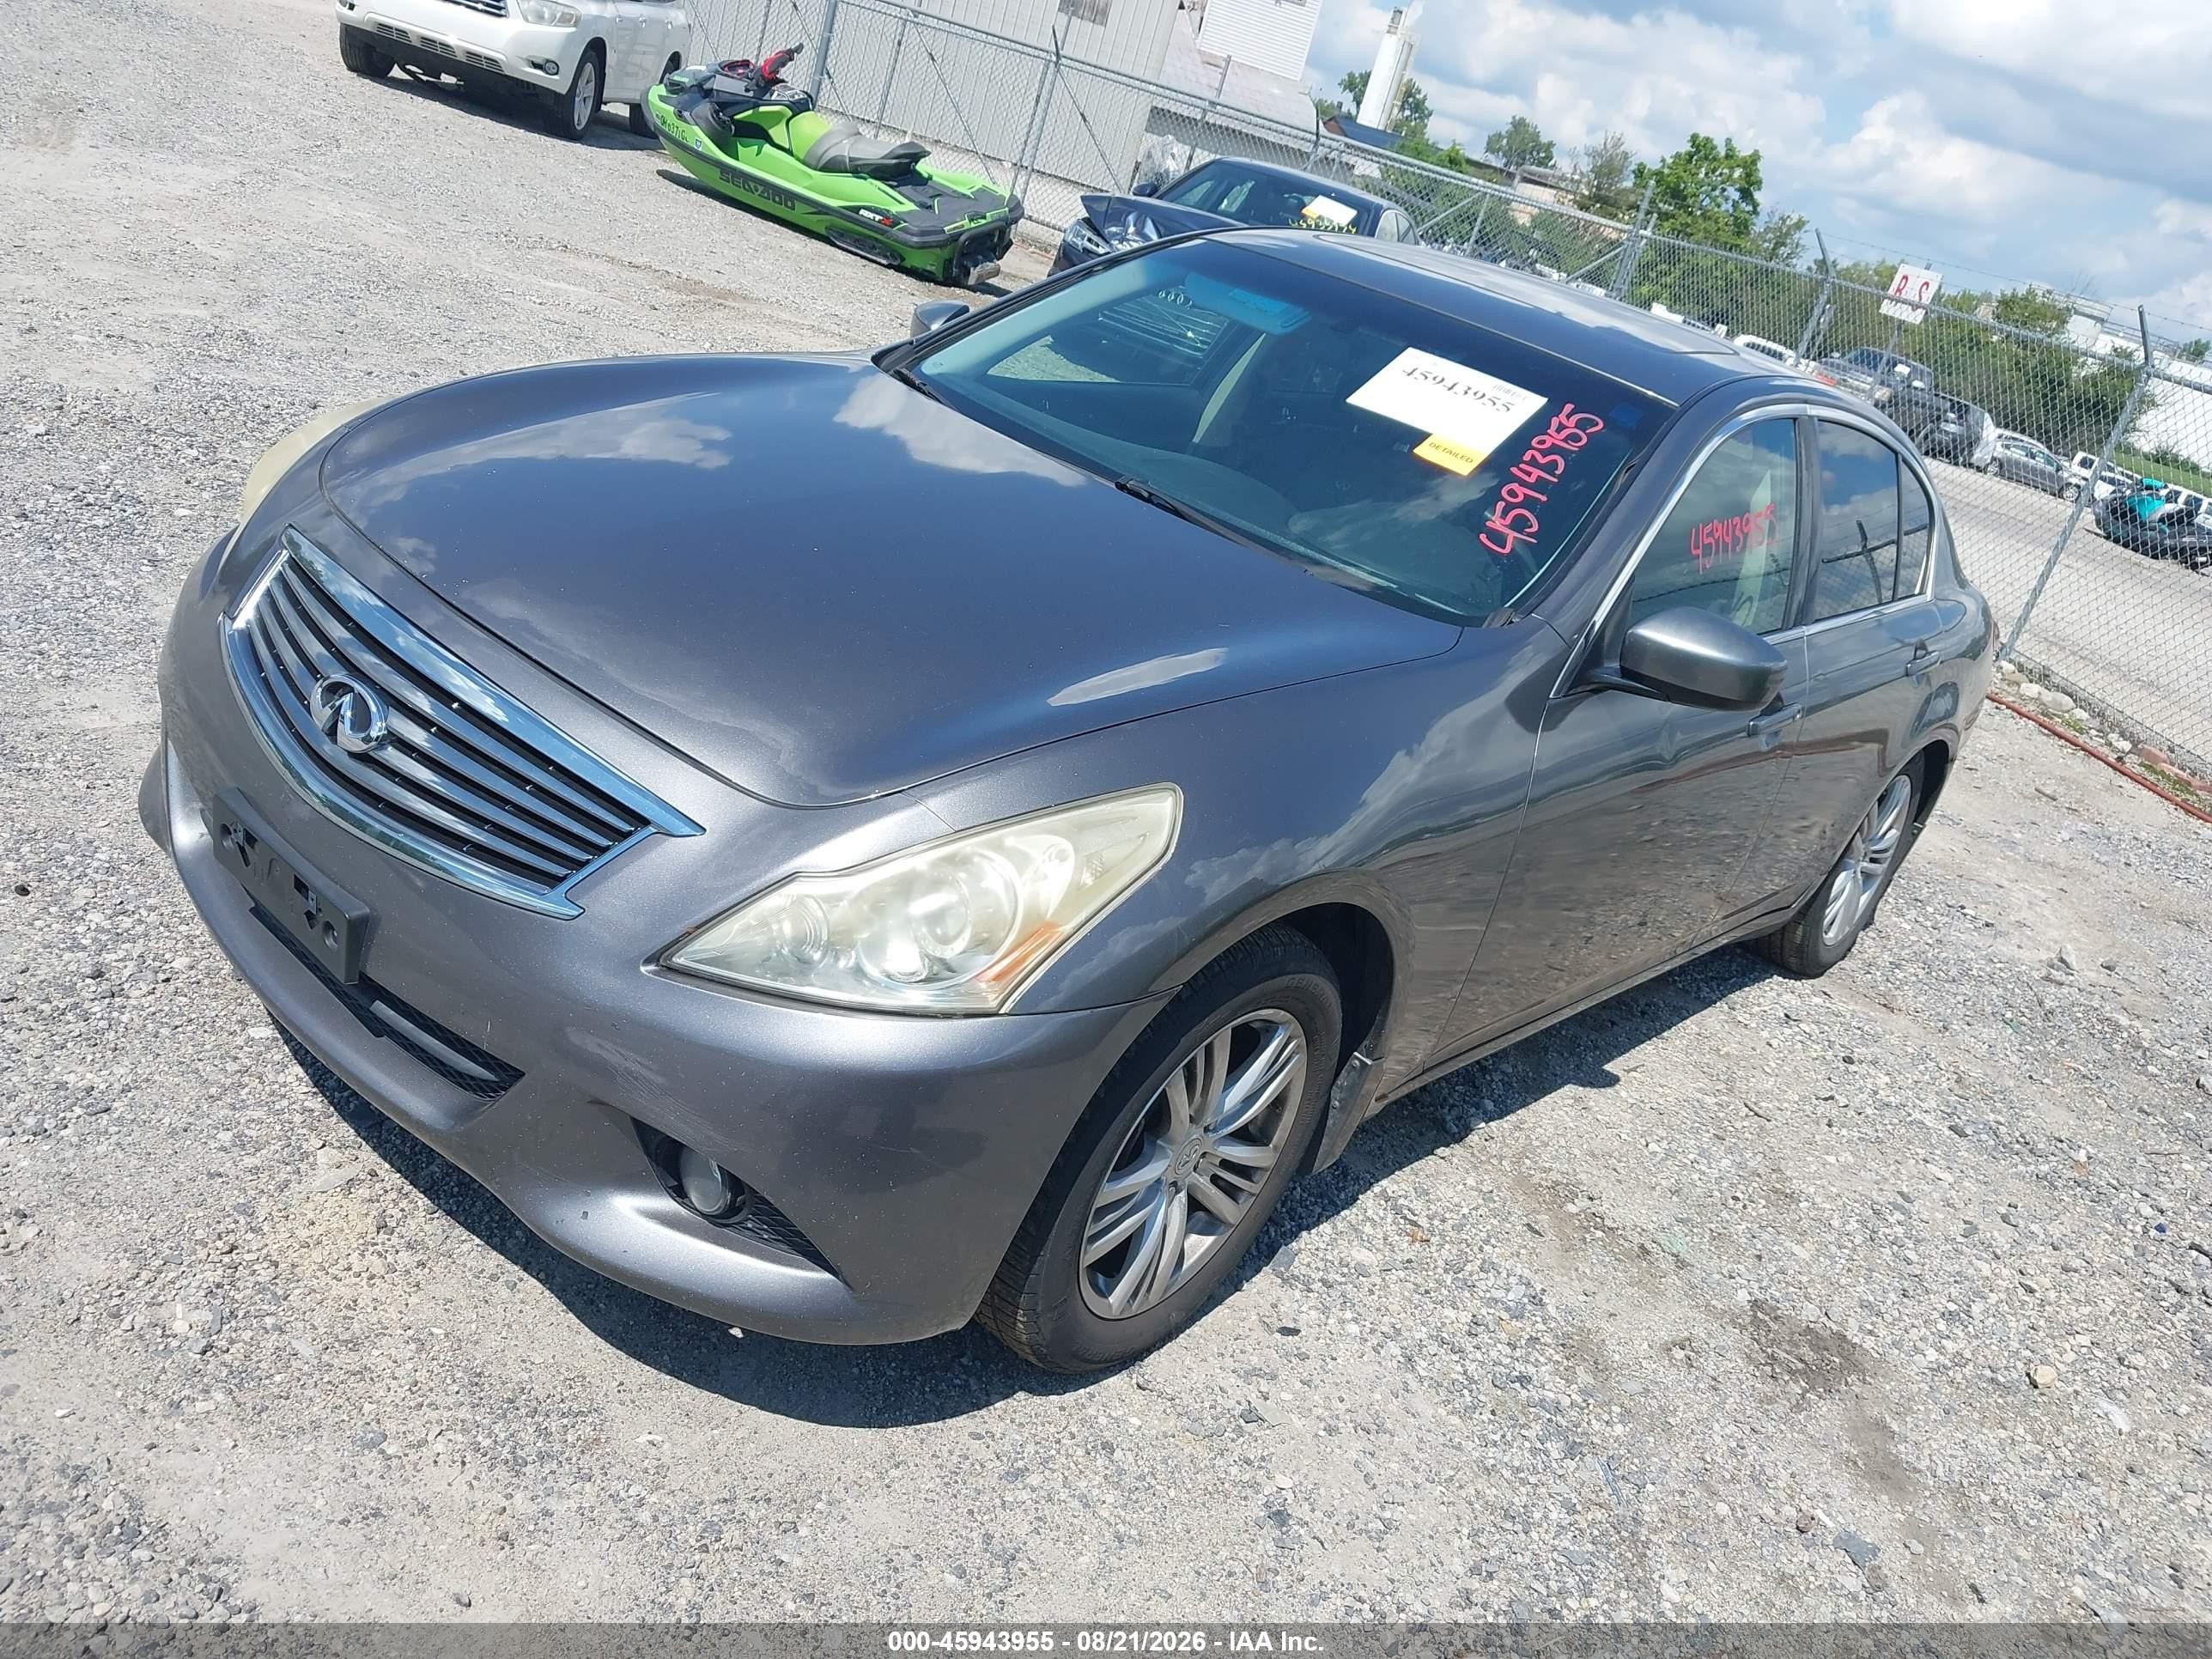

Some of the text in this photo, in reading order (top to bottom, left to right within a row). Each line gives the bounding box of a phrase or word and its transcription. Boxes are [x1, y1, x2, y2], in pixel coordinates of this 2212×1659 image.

[1401, 367, 1516, 412] 45943955
[1427, 441, 1474, 464] DETAILED
[1478, 403, 1605, 555] 45943955
